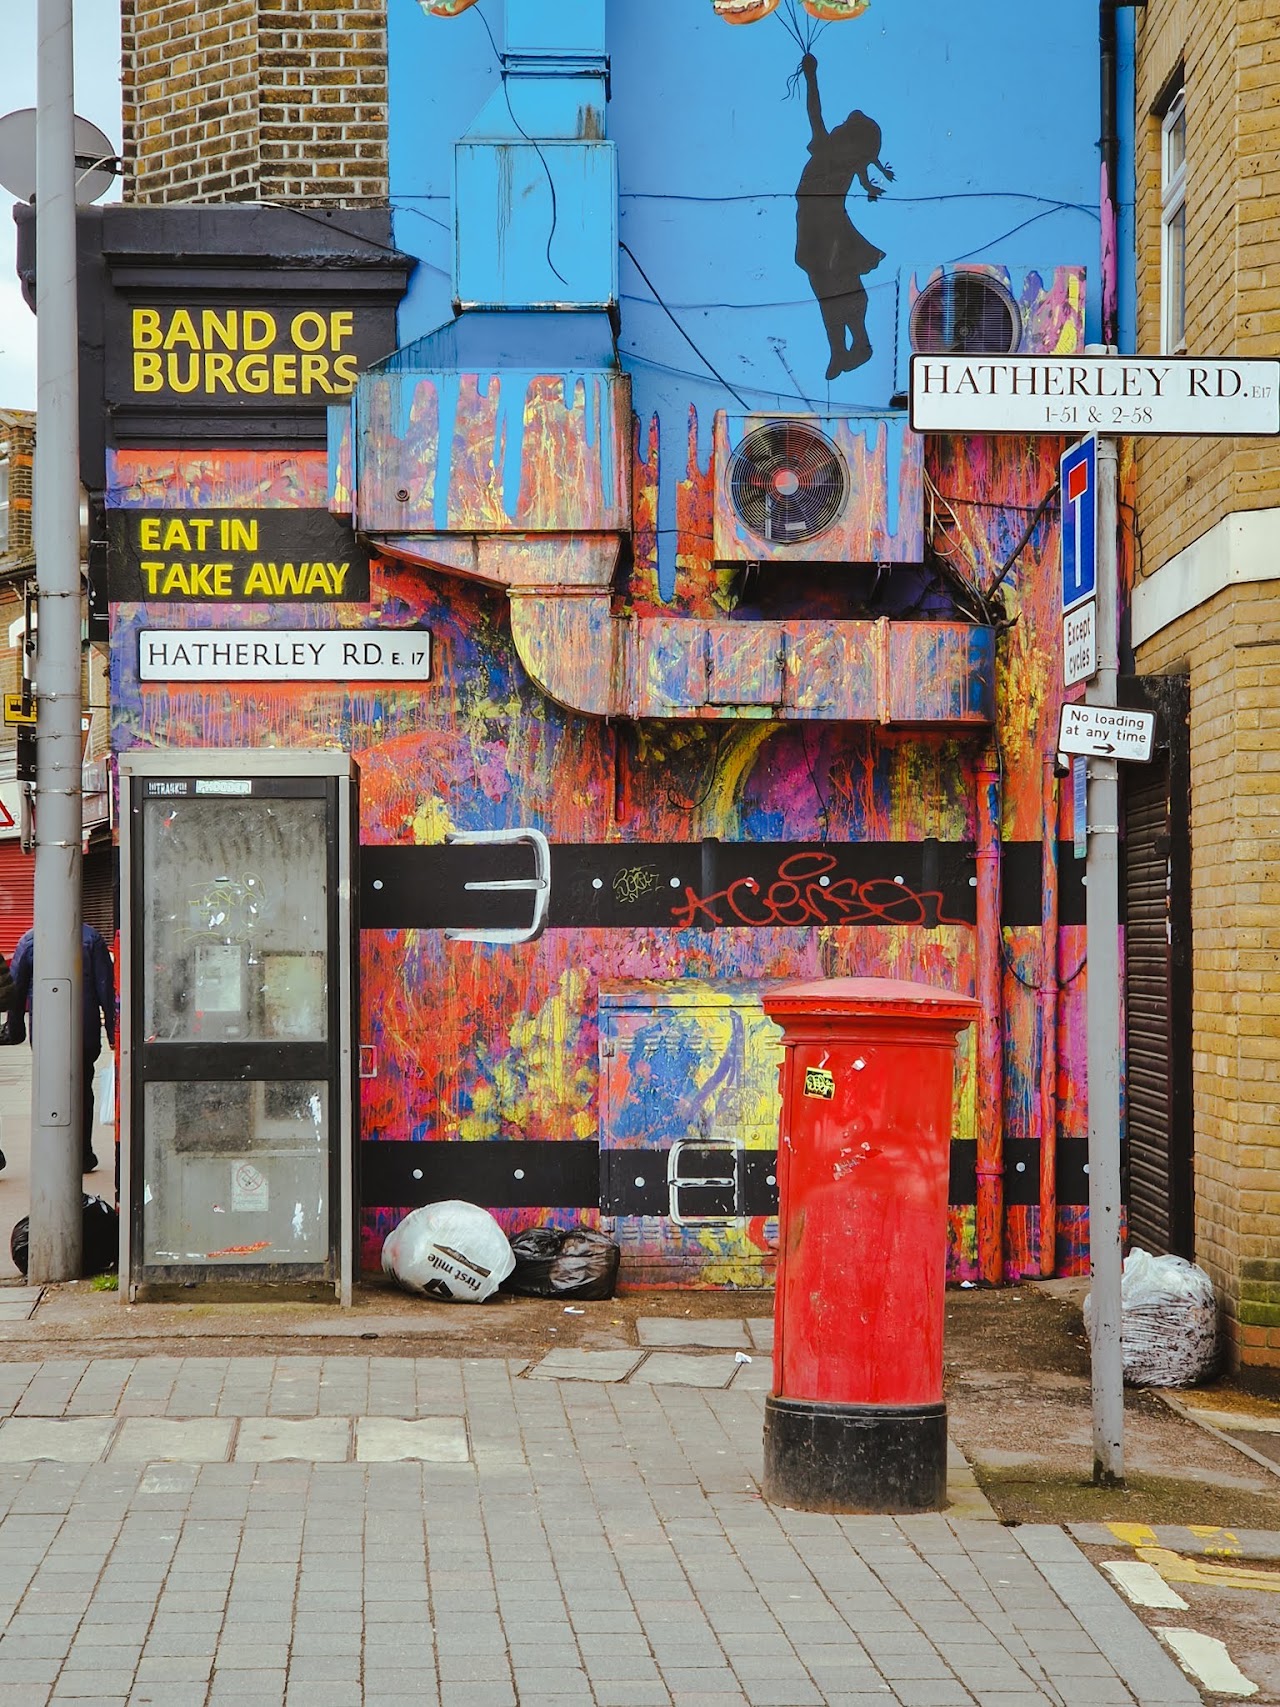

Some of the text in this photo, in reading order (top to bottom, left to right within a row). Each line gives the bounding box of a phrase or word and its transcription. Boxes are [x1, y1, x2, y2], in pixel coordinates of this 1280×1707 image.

[132, 309, 353, 352] BAND OF
[132, 352, 358, 395] BURGERS
[921, 364, 1271, 399] HATHERLEY RD. E17
[1045, 406, 1153, 424] 1-51 & 2-58
[141, 519, 258, 551] EAT IN
[141, 562, 349, 596] TAKE AWAY
[1068, 611, 1090, 647] Except
[148, 643, 326, 667] HATHERLEY
[1069, 645, 1090, 678] cycles
[1065, 725, 1146, 743] at any time
[1070, 710, 1144, 730] No loading
[428, 1253, 482, 1291] first mile
